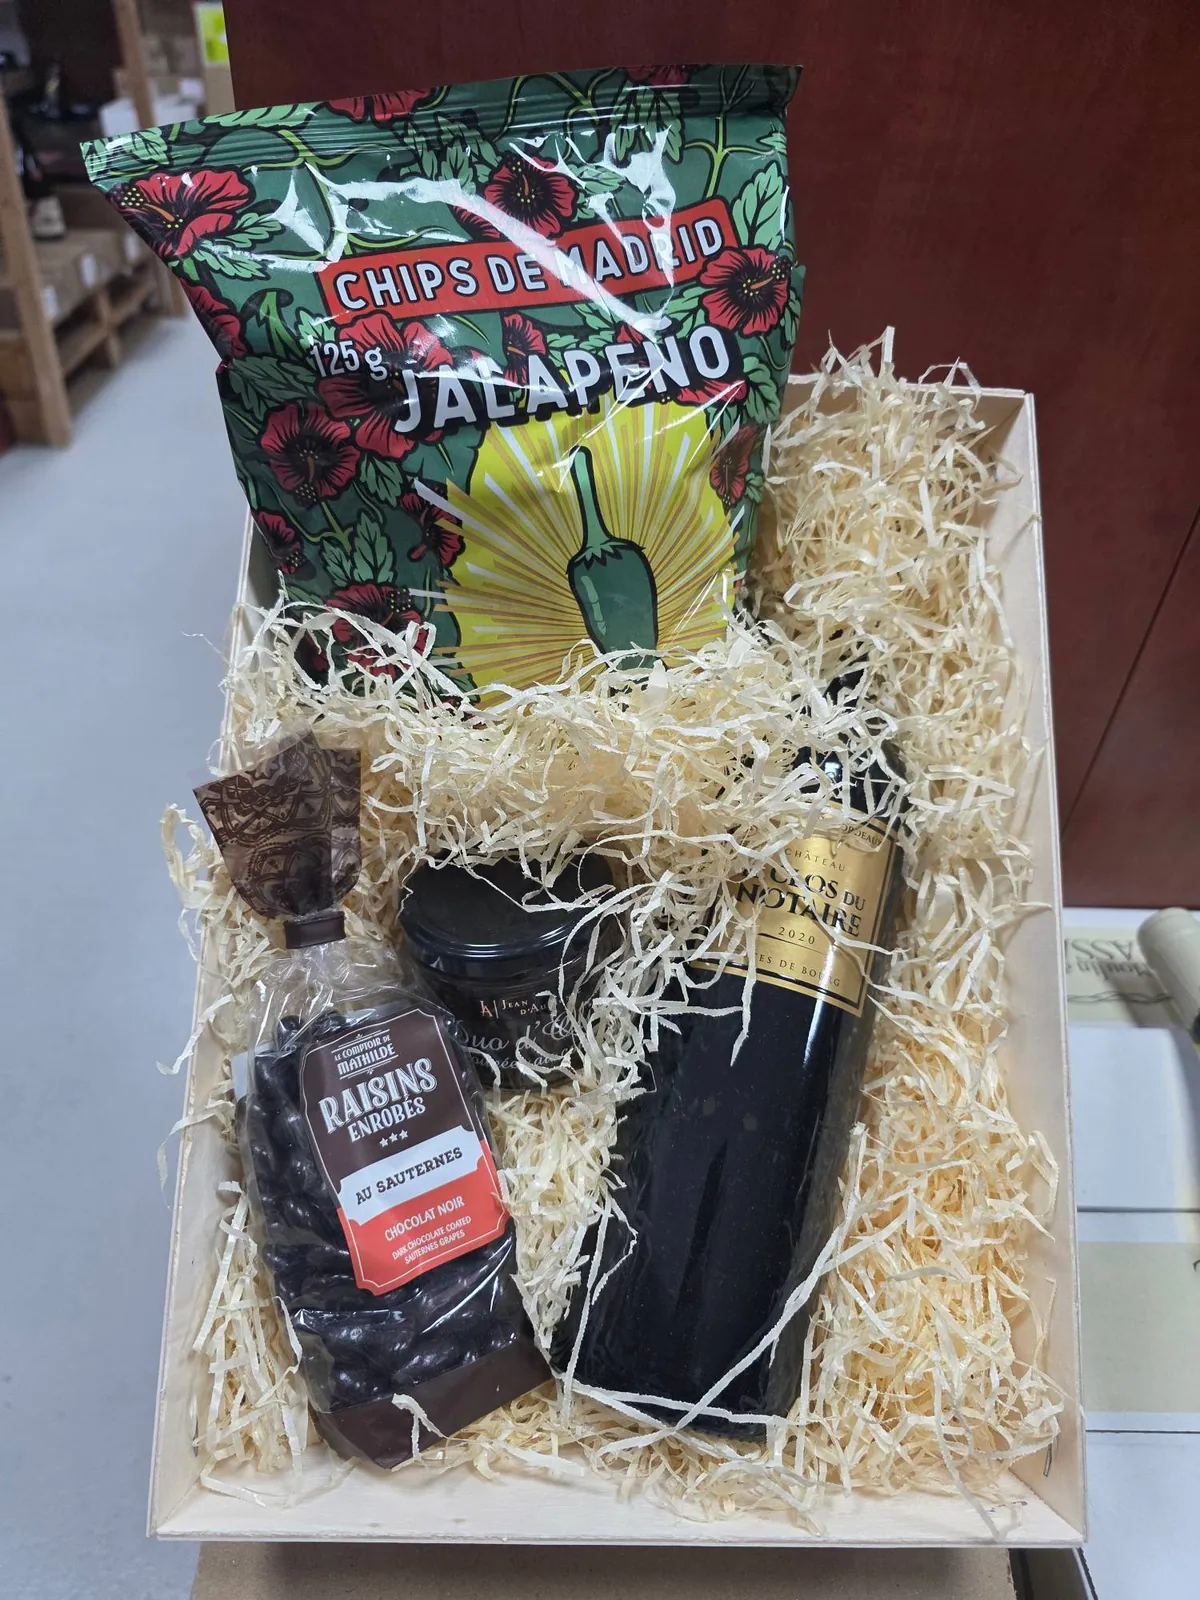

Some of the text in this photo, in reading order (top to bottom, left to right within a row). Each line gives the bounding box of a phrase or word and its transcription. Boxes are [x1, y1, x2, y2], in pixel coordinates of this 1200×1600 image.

[334, 217, 725, 311] CHIPS DE MADRID
[310, 338, 388, 382] 125 g
[785, 847, 846, 872] CHÂTEAU
[736, 881, 861, 937] NOTAIRE
[842, 890, 866, 911] DU
[778, 926, 815, 945] 2020
[779, 959, 795, 970] DE
[334, 1034, 391, 1061] LE COMPTOIR DE
[337, 1043, 396, 1075] MATHILDE
[318, 1057, 438, 1134] RAISINS
[347, 1094, 427, 1142] ENROBÉS
[356, 1146, 464, 1205] AU SAUTERNES
[384, 1195, 465, 1242] CHOCOLAT NOIR
[392, 1215, 472, 1260] DARK CHOCOLATE COATED
[404, 1229, 466, 1265] SAUTERNES GRAPES
